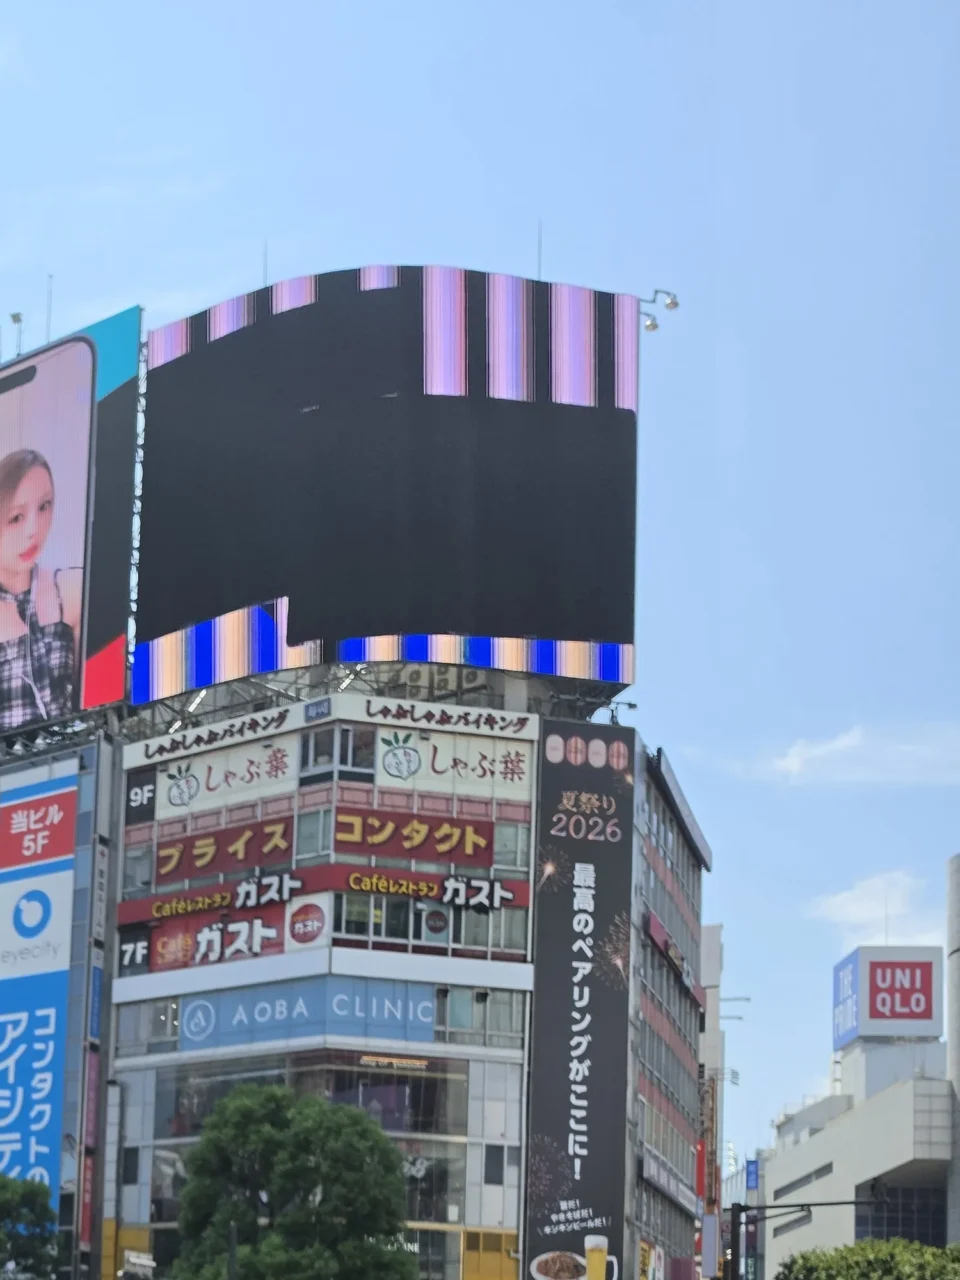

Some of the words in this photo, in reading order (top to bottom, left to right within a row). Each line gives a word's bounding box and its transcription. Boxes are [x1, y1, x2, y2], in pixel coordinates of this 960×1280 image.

[365, 699, 530, 733] しゃぶしゃぶバイキング
[144, 709, 290, 760] しゃぶしゃぶバイキング
[205, 747, 289, 793] しゃぶ葉
[431, 744, 526, 783] しゃぶ葉
[129, 784, 155, 808] 9F
[557, 790, 618, 816] 夏祭り
[9, 803, 65, 834] 当ビル
[335, 813, 488, 855] コンタクト
[550, 812, 622, 843] 2026
[21, 831, 51, 857] 5F
[234, 872, 303, 910] ガスト
[441, 876, 515, 910] ガスト
[120, 940, 149, 967] 7F
[194, 917, 278, 965] ガスト
[875, 967, 923, 989] UNI
[231, 996, 309, 1027] AOBA
[331, 993, 434, 1024] CLINIC
[875, 991, 927, 1017] QLO
